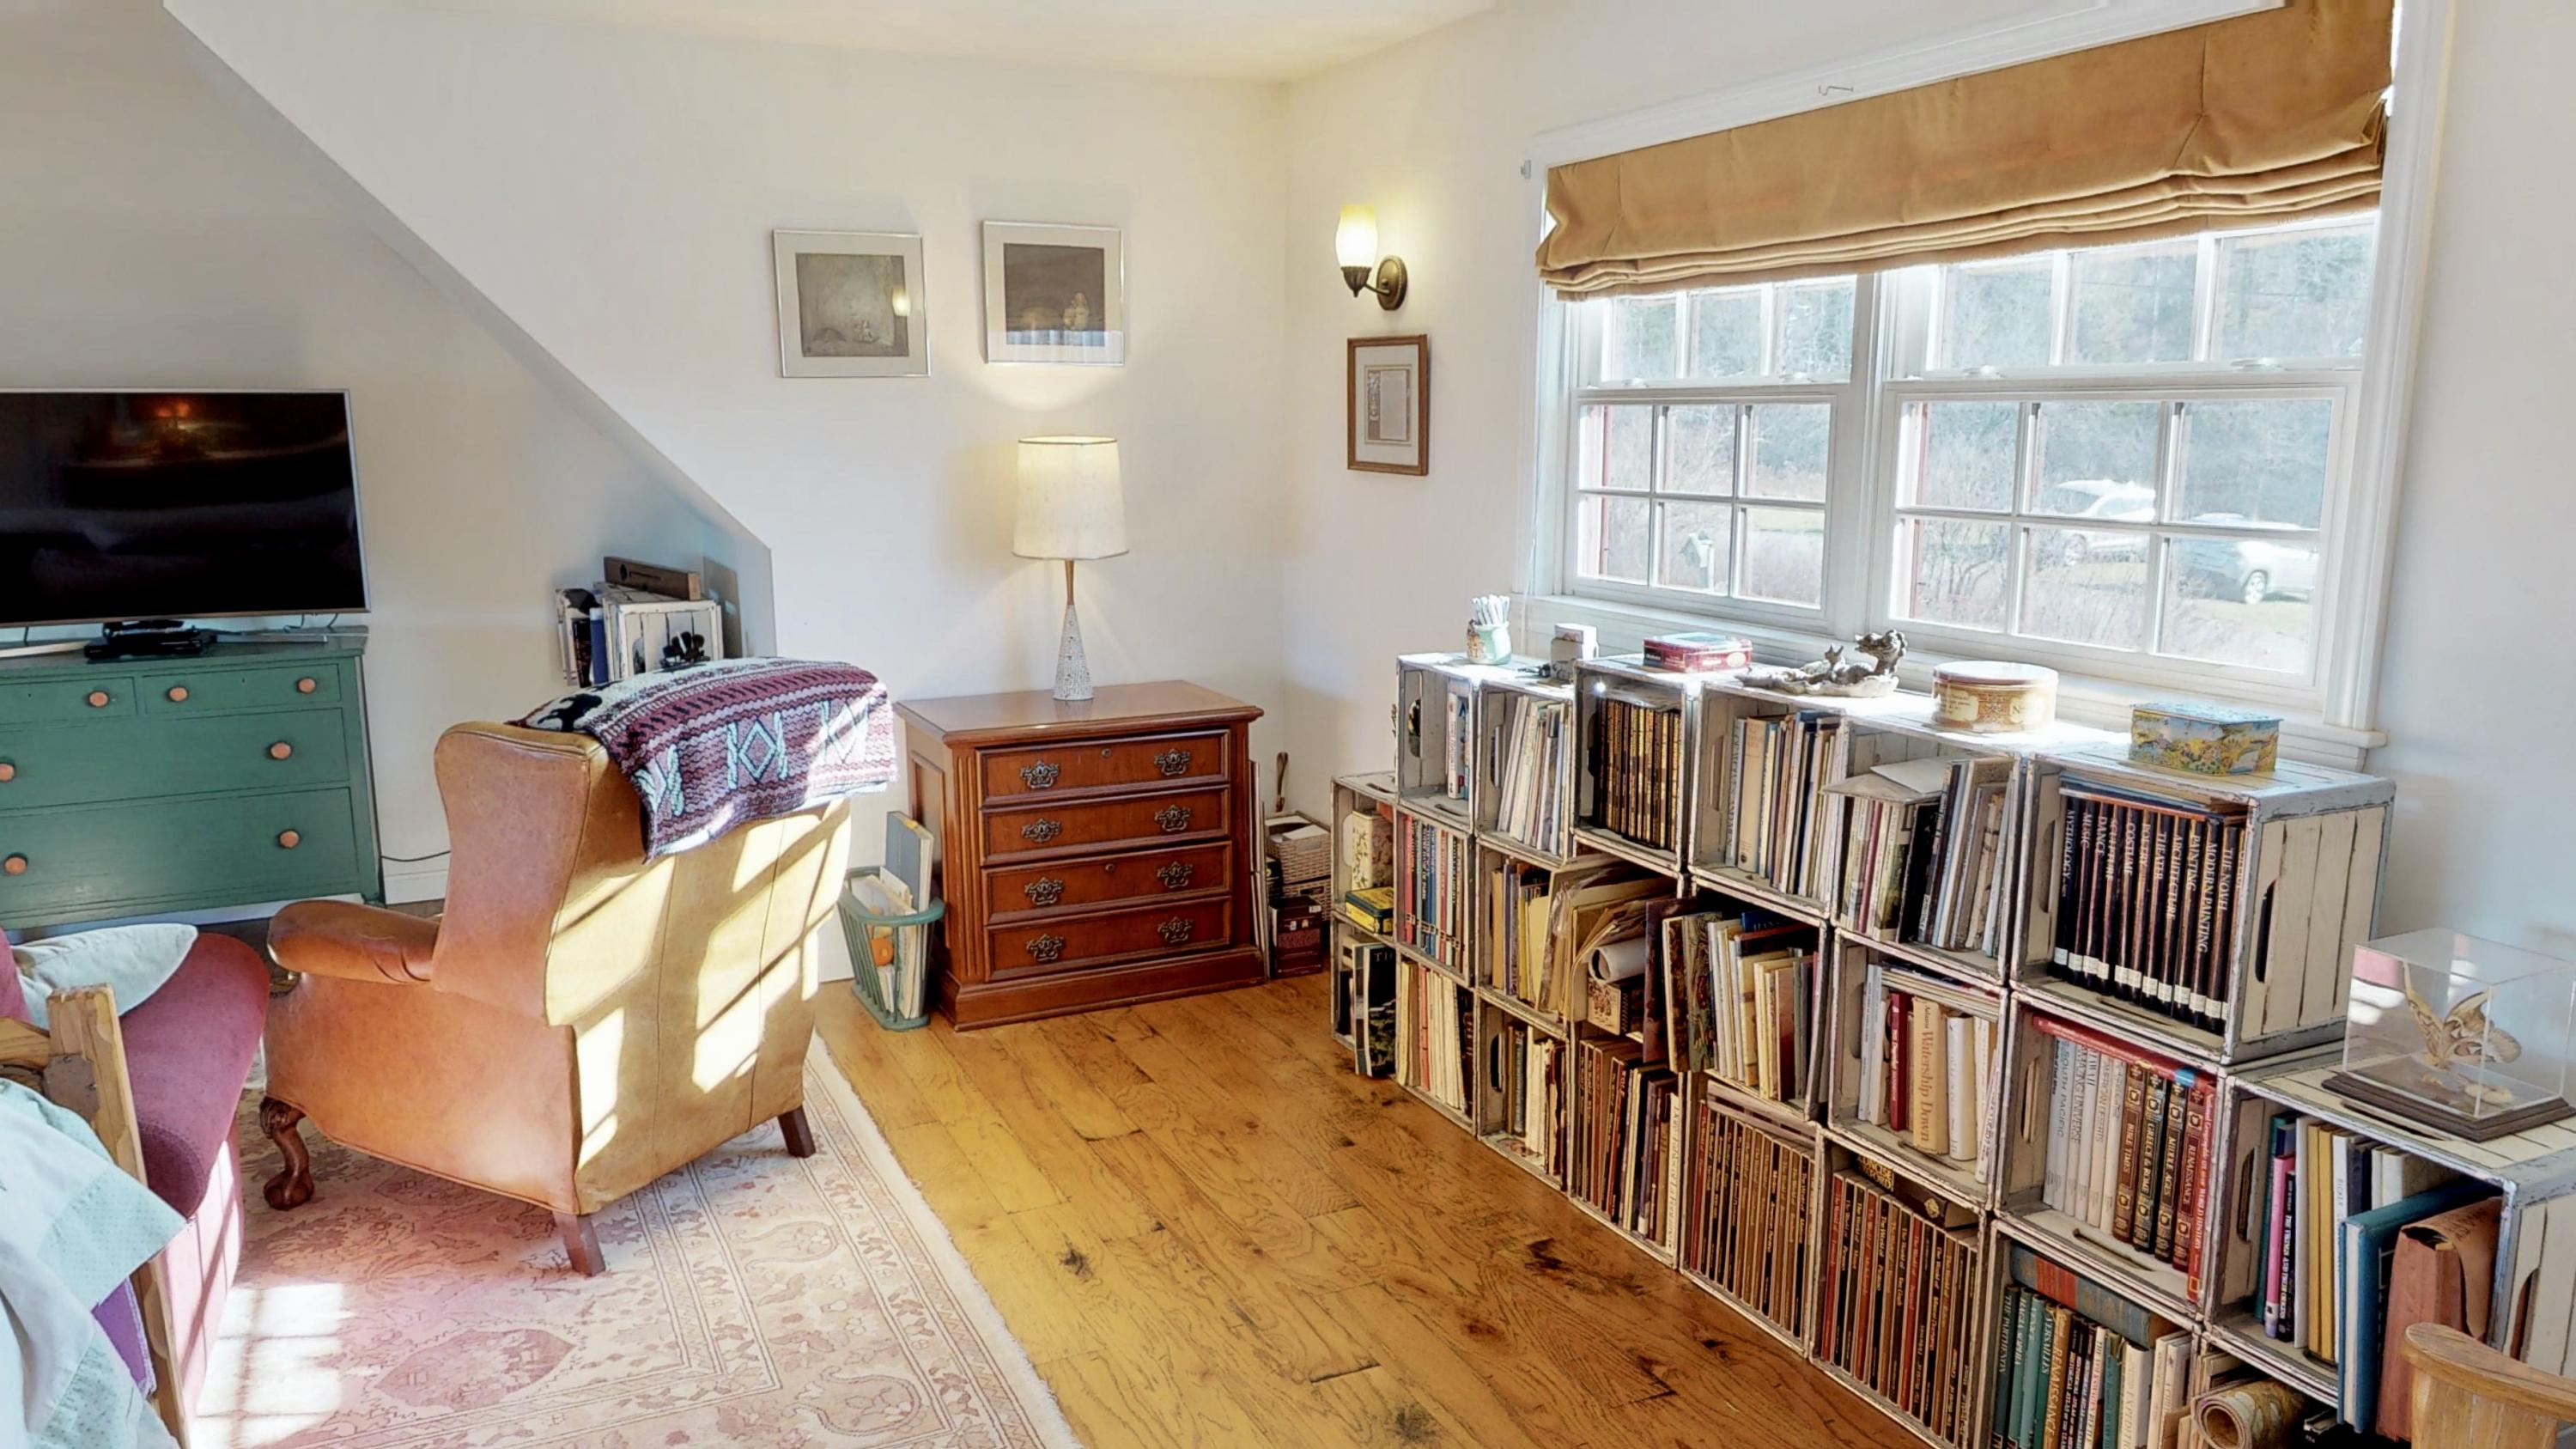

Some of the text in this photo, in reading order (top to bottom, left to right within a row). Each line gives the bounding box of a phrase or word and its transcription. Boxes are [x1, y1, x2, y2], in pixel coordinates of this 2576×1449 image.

[2061, 809, 2075, 879] MYTHOLOGY
[2080, 813, 2092, 849] MUSIC
[2094, 815, 2108, 856] DANCE
[2105, 818, 2119, 880] SCULPTURE
[2123, 822, 2136, 875] COSTUME
[2139, 824, 2151, 867] POETRY
[2154, 831, 2166, 880] THEATER
[2166, 834, 2183, 920] ARCHITECTURE
[2187, 835, 2201, 891] PAINTING
[2219, 847, 2233, 910] THE NOVEL
[2198, 843, 2216, 953] MODERN PAINTING
[1918, 1032, 1933, 1096] Watership
[1920, 1102, 1932, 1142] Down
[2070, 1094, 2085, 1144] UNIVERSE
[2096, 1105, 2105, 1142] DESERTS
[2145, 1123, 2155, 1158] GREECE
[2123, 1123, 2134, 1174] BIBLE TIMES
[2164, 1136, 2176, 1196] MIDDLE AGES
[2184, 1144, 2195, 1205] RENAISSANCE
[2142, 1168, 2151, 1194] ROME
[1999, 1317, 2010, 1373] PARTHENON
[2015, 1297, 2026, 1366] HAGIA SOPHIA
[2042, 1318, 2052, 1374] VERSAILLES
[2046, 1345, 2063, 1436] RENAISSANCE
